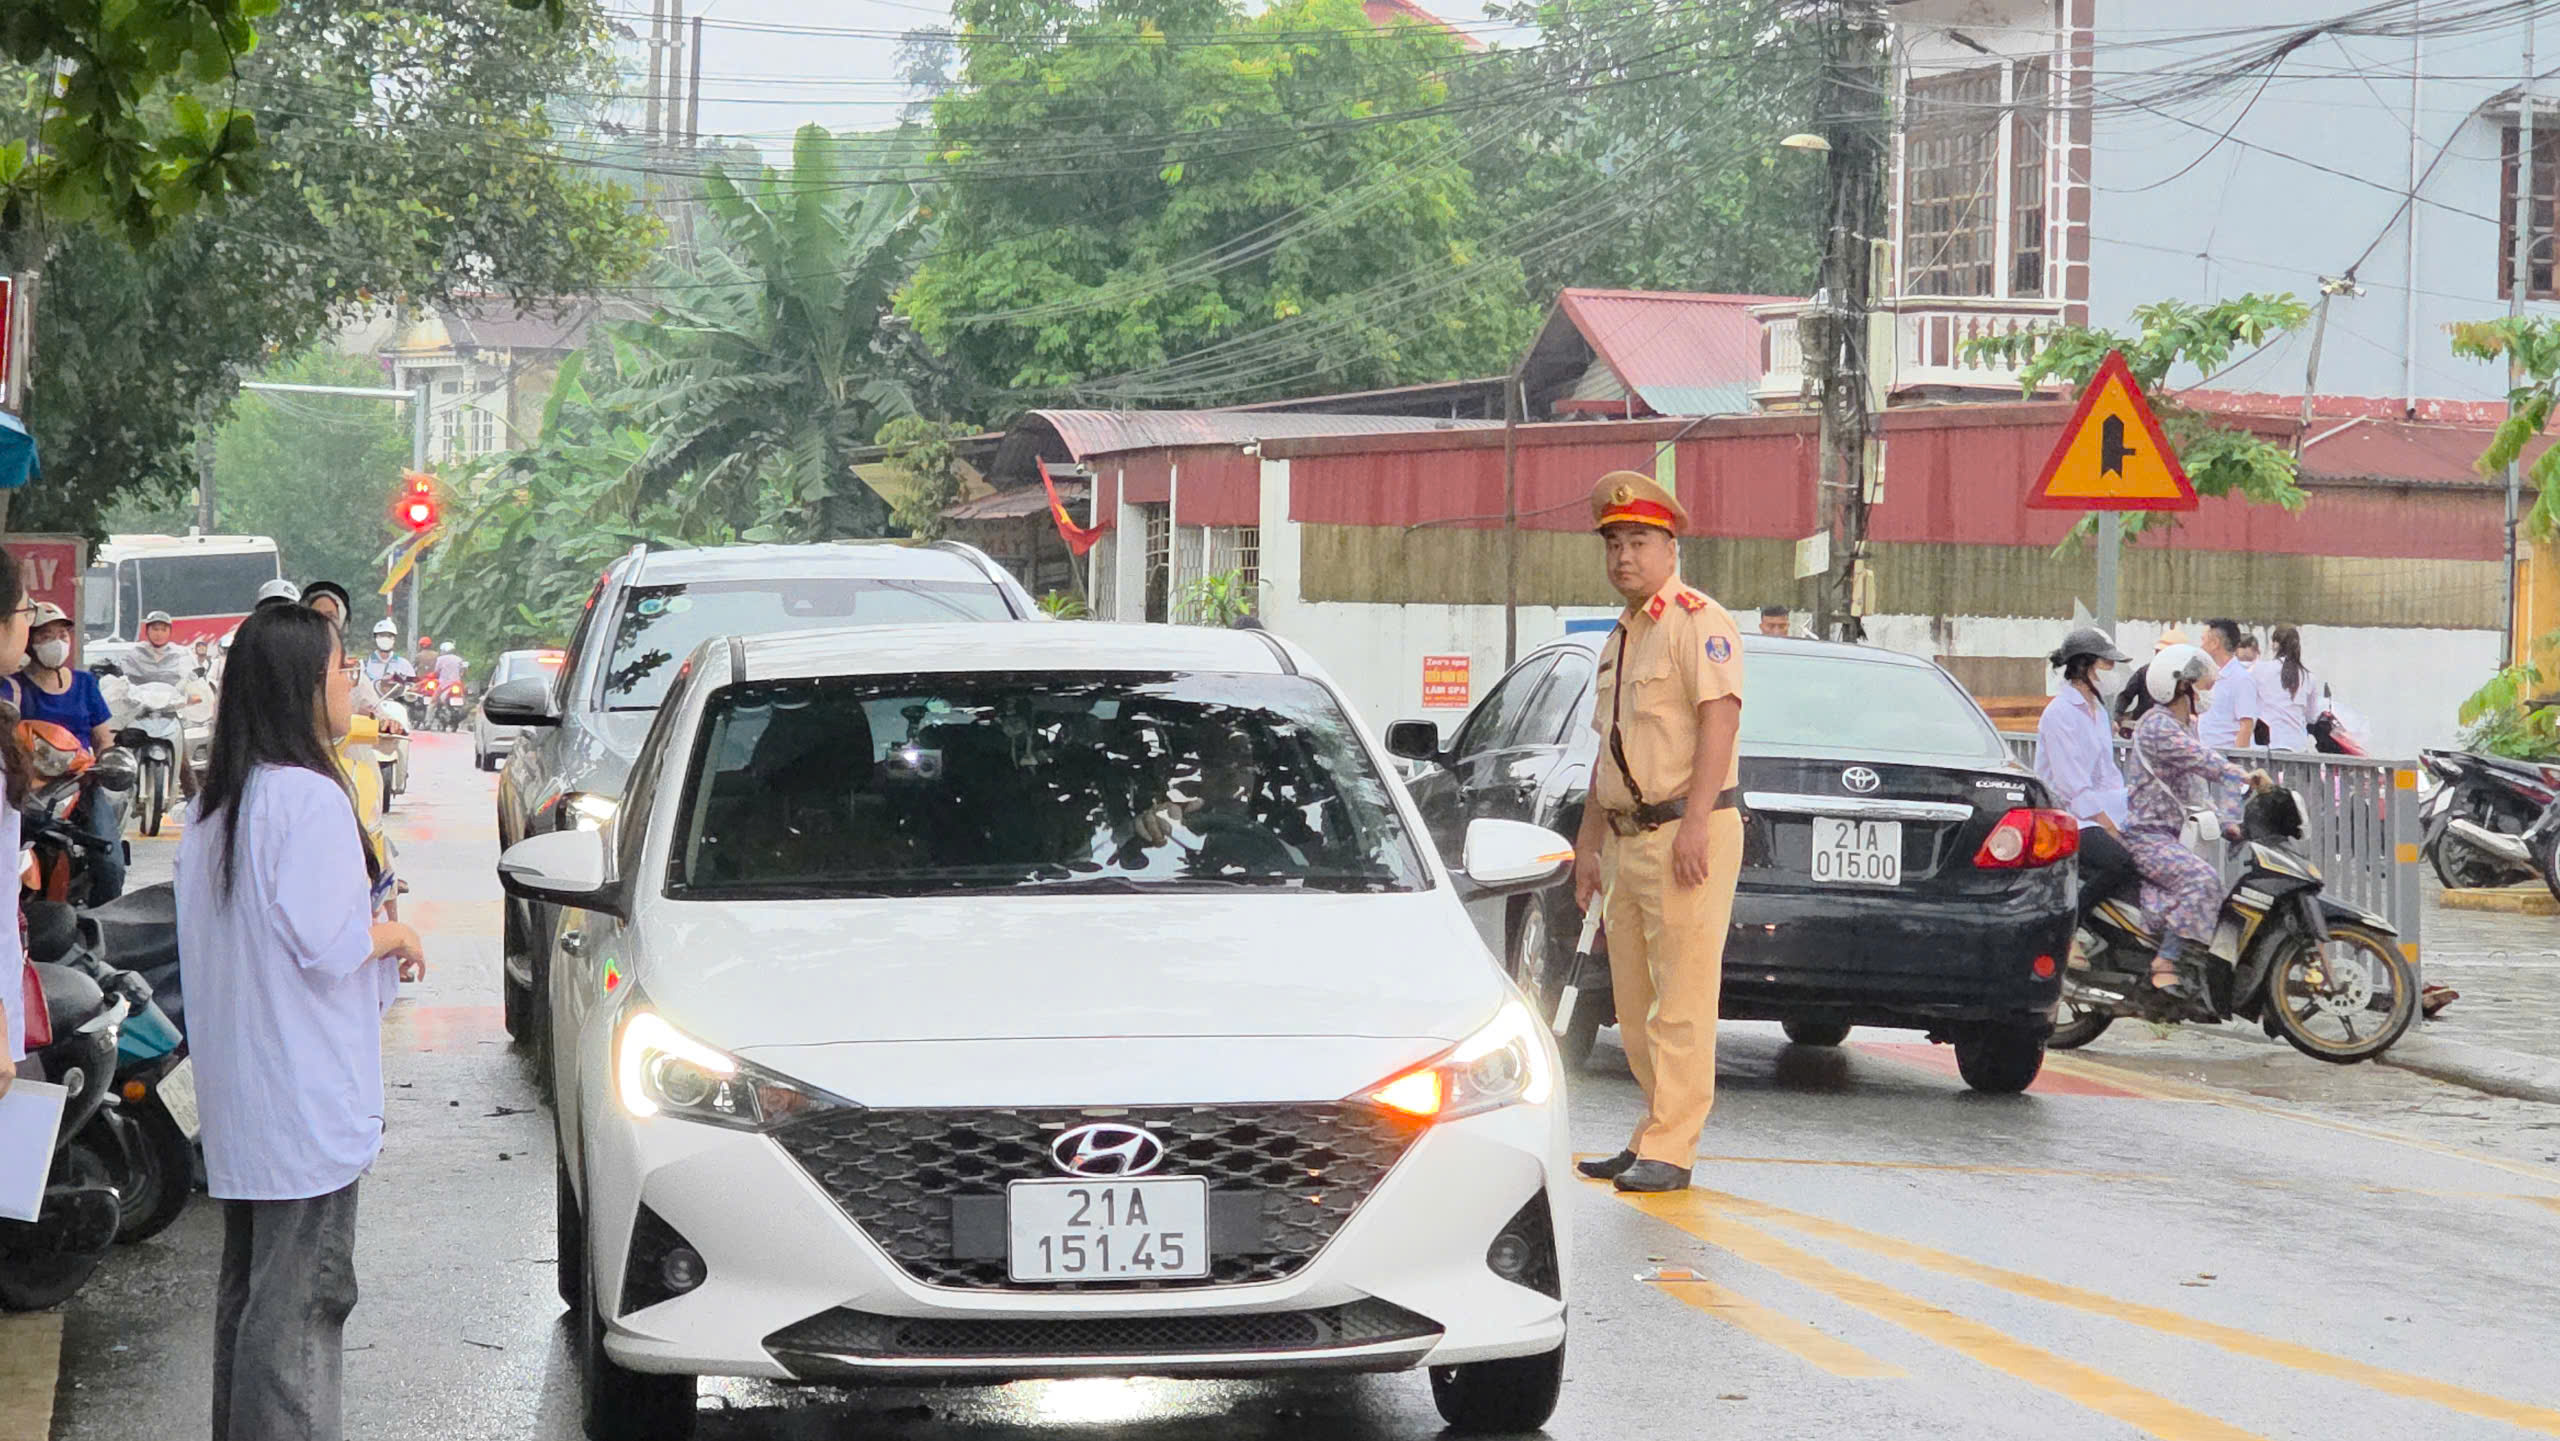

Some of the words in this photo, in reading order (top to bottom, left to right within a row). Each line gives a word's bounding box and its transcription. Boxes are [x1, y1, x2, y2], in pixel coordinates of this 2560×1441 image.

[1975, 780, 2026, 791] COROLLA
[1834, 822, 1878, 851] 21A
[1816, 851, 1896, 881] 015.00
[1067, 1187, 1149, 1227] 21A
[1039, 1232, 1184, 1273] 151.45
